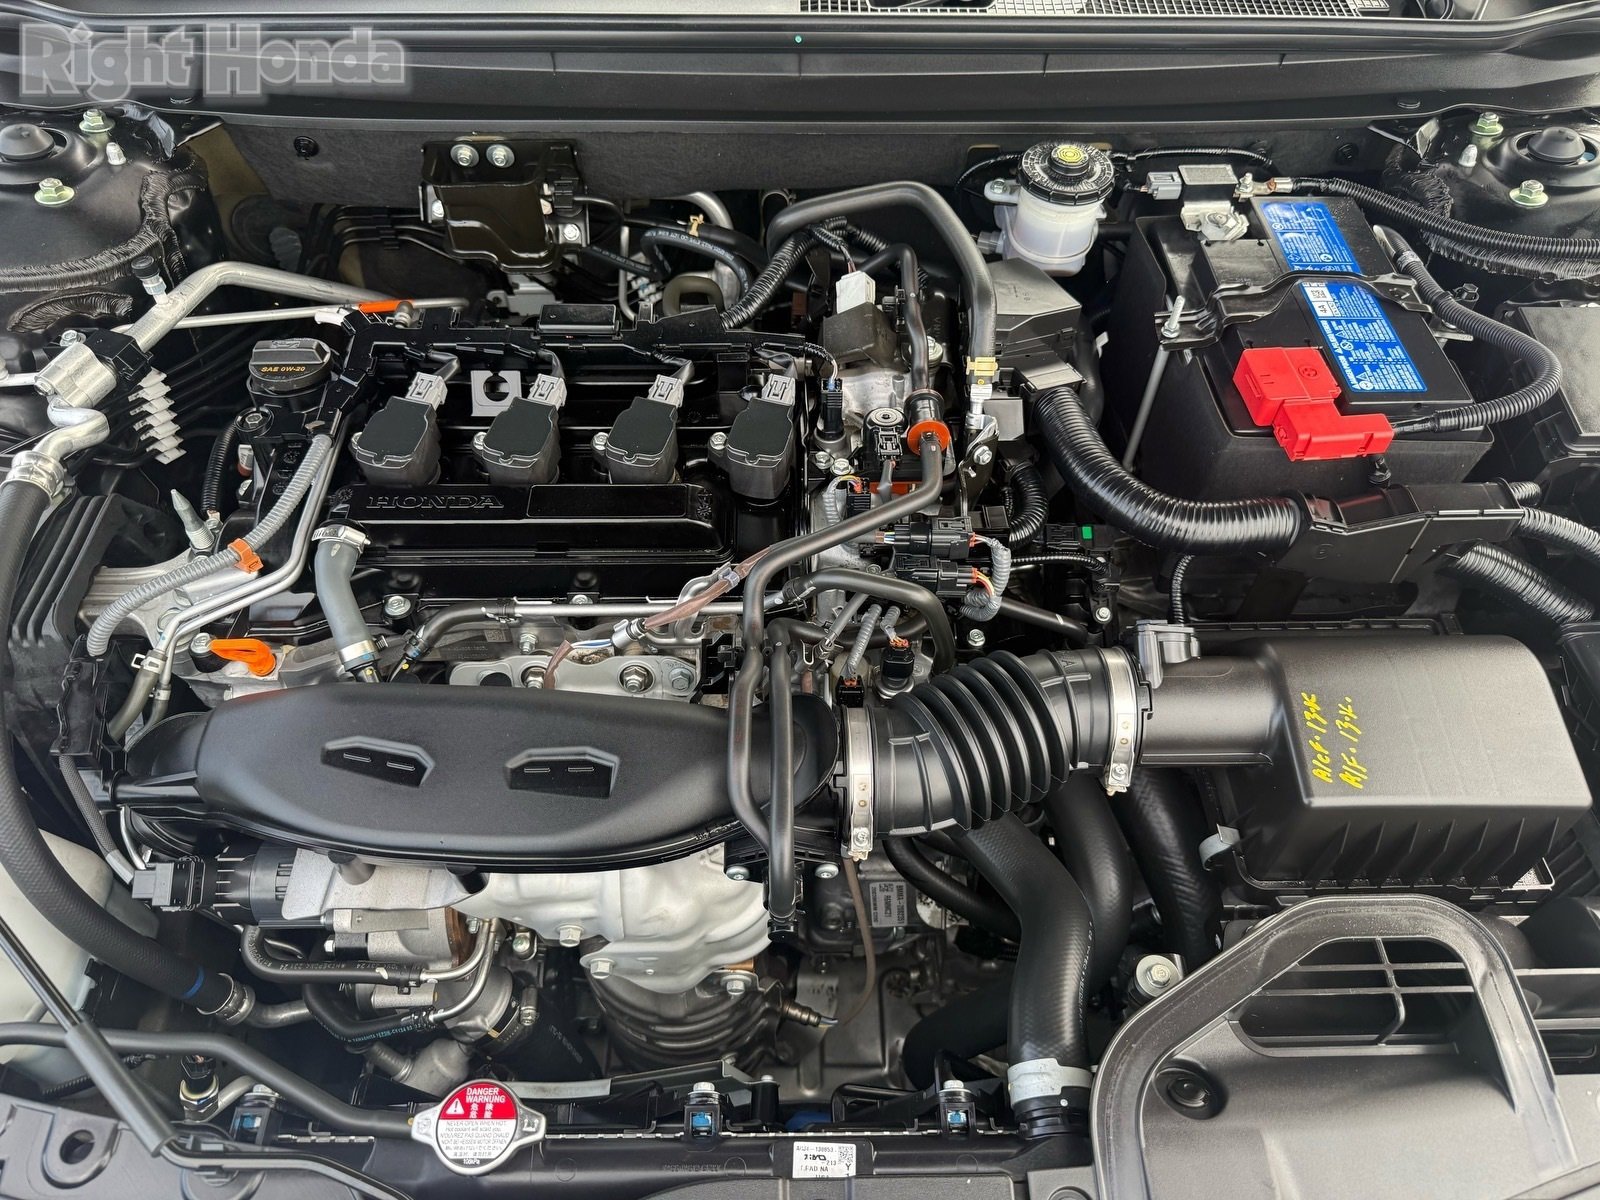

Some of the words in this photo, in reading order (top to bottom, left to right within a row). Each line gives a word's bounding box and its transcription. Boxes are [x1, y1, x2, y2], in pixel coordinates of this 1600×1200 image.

[366, 495, 504, 508] HONDA
[466, 1087, 499, 1096] DANGER
[465, 1095, 506, 1103] WARNUNG
[845, 1163, 852, 1171] Y
